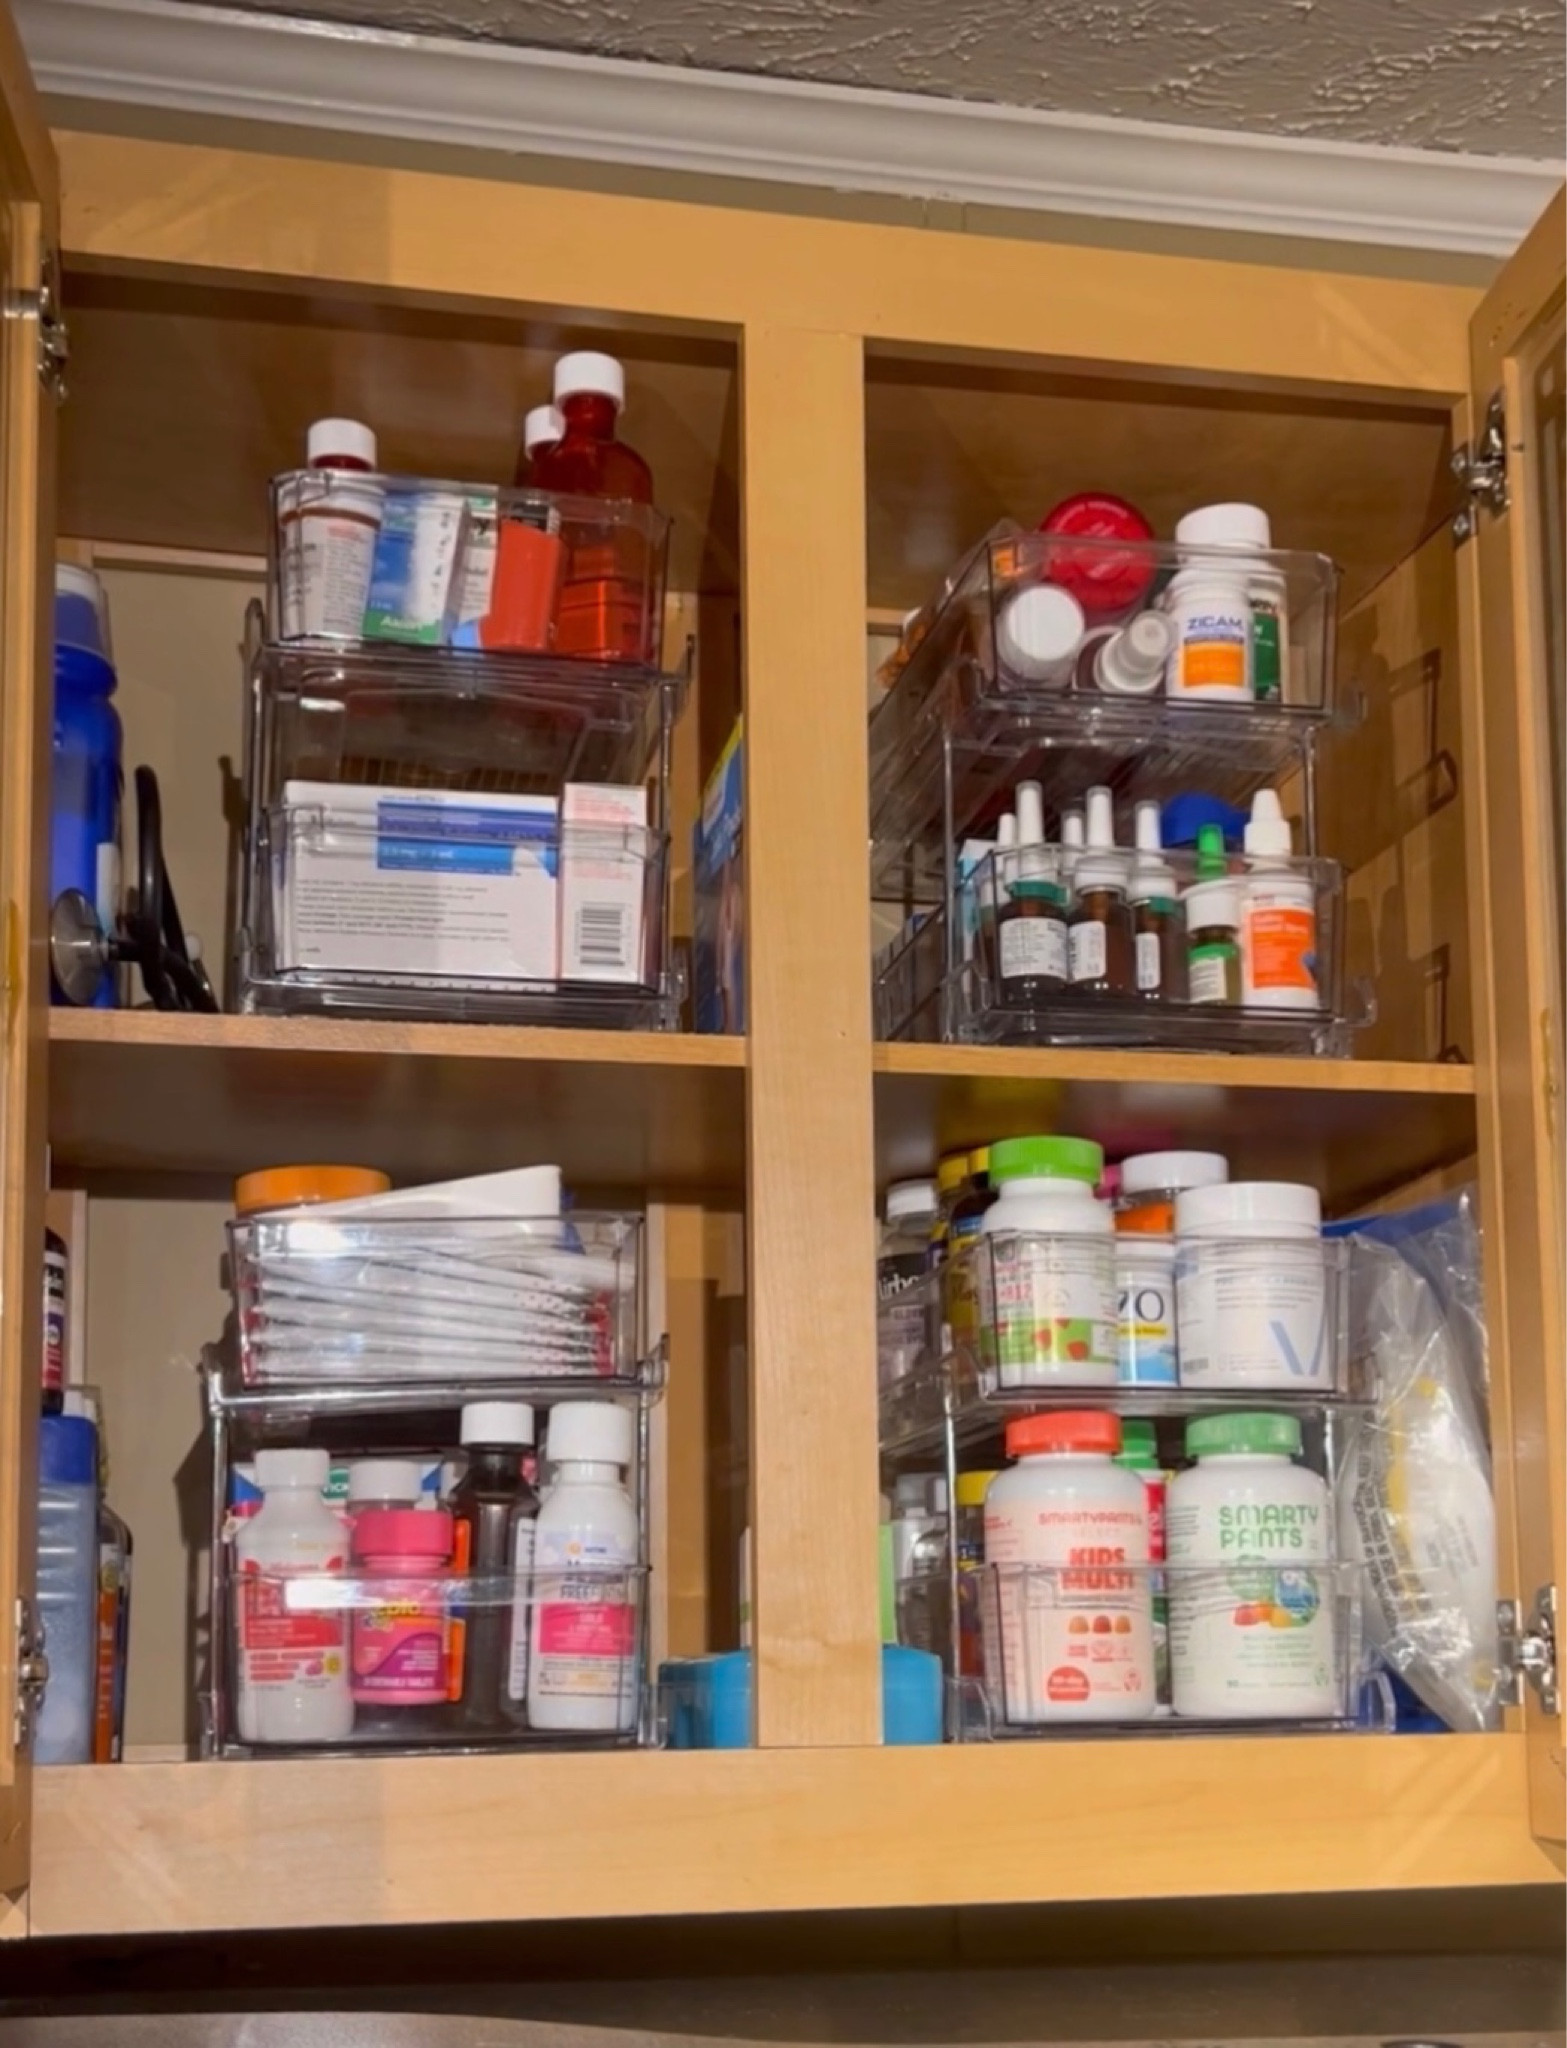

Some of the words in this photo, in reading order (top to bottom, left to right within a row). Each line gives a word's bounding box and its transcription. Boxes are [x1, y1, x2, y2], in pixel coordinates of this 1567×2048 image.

[1186, 615, 1244, 632] ZICAM
[1219, 1503, 1319, 1526] SMARTY
[1220, 1527, 1303, 1549] PANTS
[1069, 1546, 1125, 1567] KIDS
[1061, 1567, 1134, 1590] MULTI
